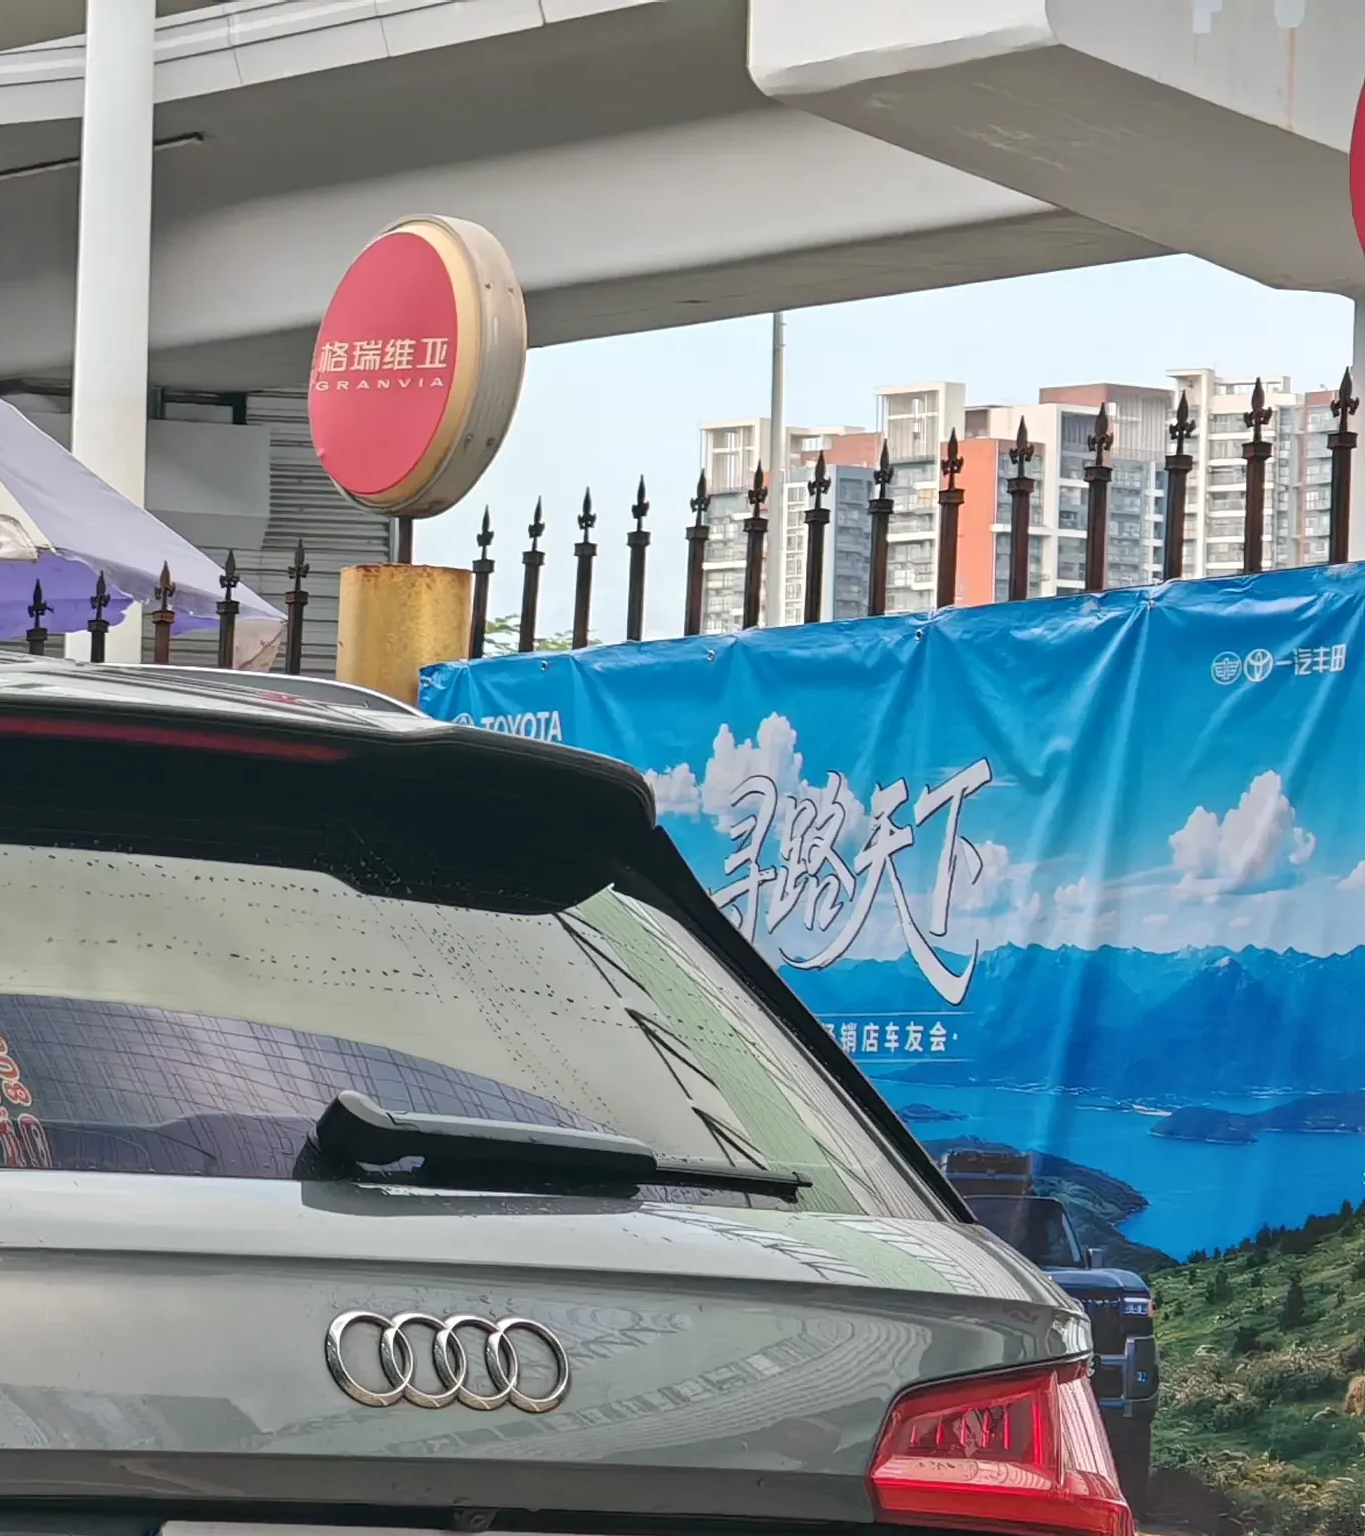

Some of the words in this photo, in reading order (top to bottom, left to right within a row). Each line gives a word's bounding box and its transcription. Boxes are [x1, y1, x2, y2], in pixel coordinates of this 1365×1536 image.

[319, 337, 449, 374] 格瑞维亚
[315, 377, 445, 392] GRANVIA
[1276, 643, 1347, 676] 一汽丰田
[709, 756, 993, 1006] 寻路天下
